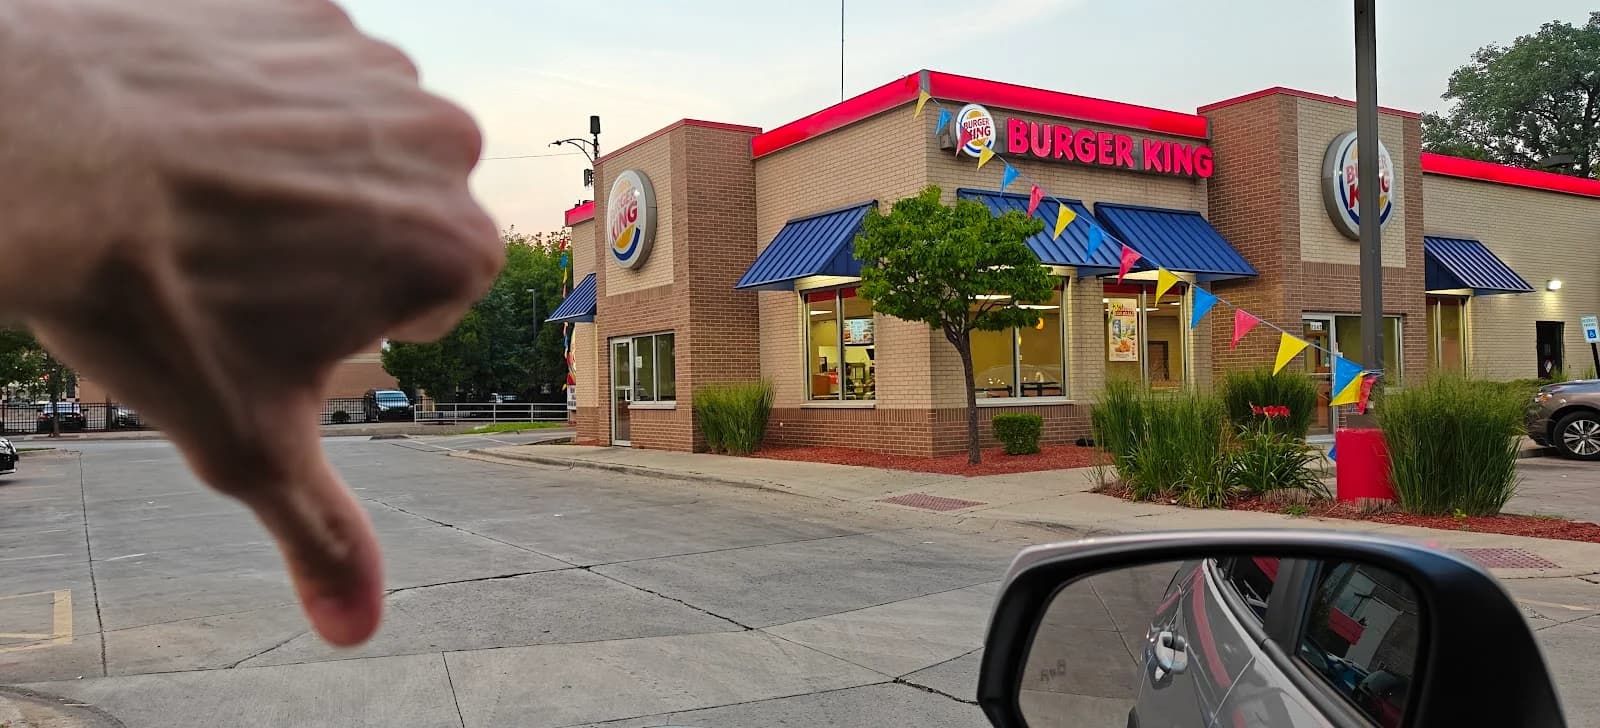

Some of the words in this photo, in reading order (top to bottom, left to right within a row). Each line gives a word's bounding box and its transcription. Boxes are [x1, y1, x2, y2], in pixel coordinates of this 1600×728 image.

[963, 117, 990, 129] BURGER
[968, 126, 991, 139] ING
[1007, 117, 1135, 170] BURGER
[1143, 138, 1214, 178] KING
[1349, 171, 1390, 210] KG
